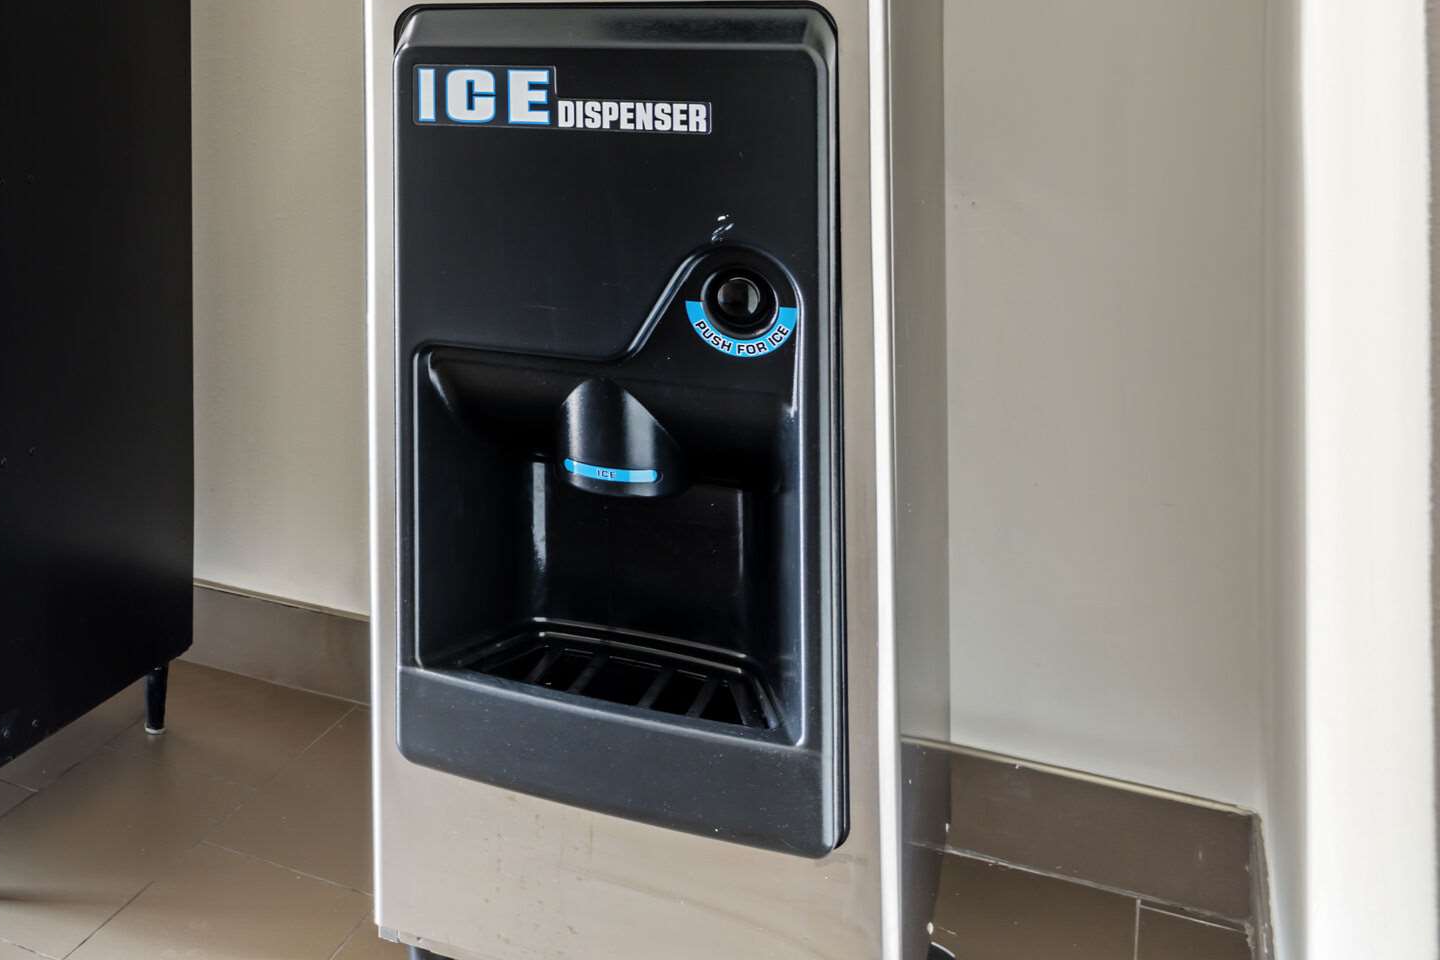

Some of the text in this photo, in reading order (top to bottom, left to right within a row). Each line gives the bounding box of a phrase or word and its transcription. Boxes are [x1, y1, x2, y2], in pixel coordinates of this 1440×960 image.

[417, 68, 708, 133] ICE DISPENSER
[695, 320, 790, 355] PUSH FOR ICE
[597, 469, 617, 479] ICE
